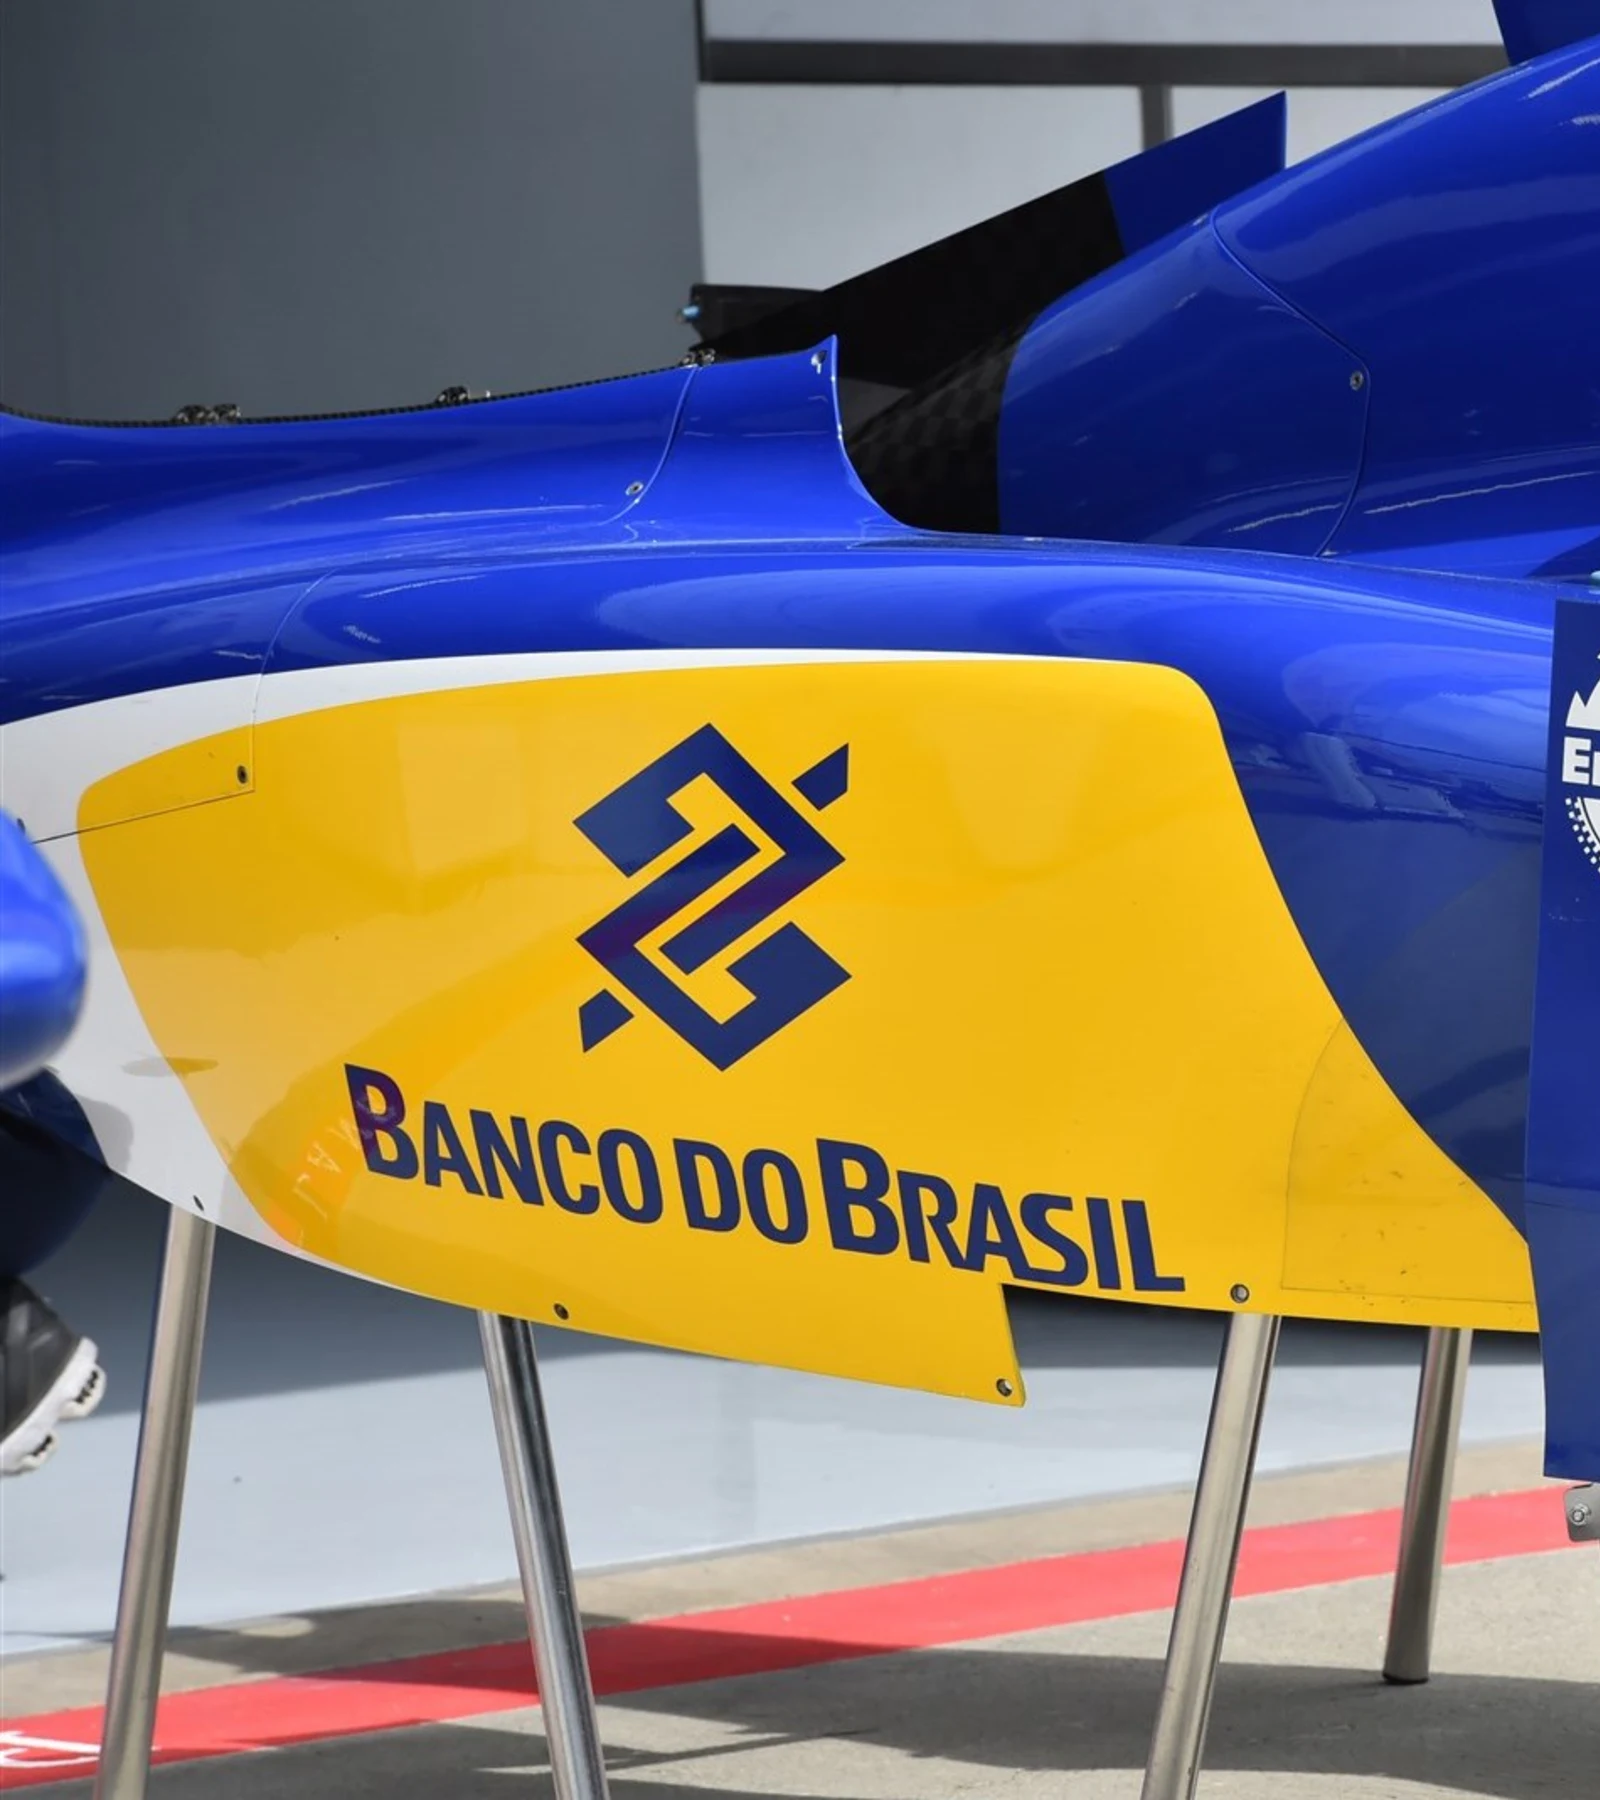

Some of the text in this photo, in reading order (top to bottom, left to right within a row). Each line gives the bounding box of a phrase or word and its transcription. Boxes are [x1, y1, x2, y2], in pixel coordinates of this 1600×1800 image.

[344, 1063, 664, 1225] BANCO
[673, 1137, 810, 1246] DO
[816, 1137, 1186, 1293] BRASIL
